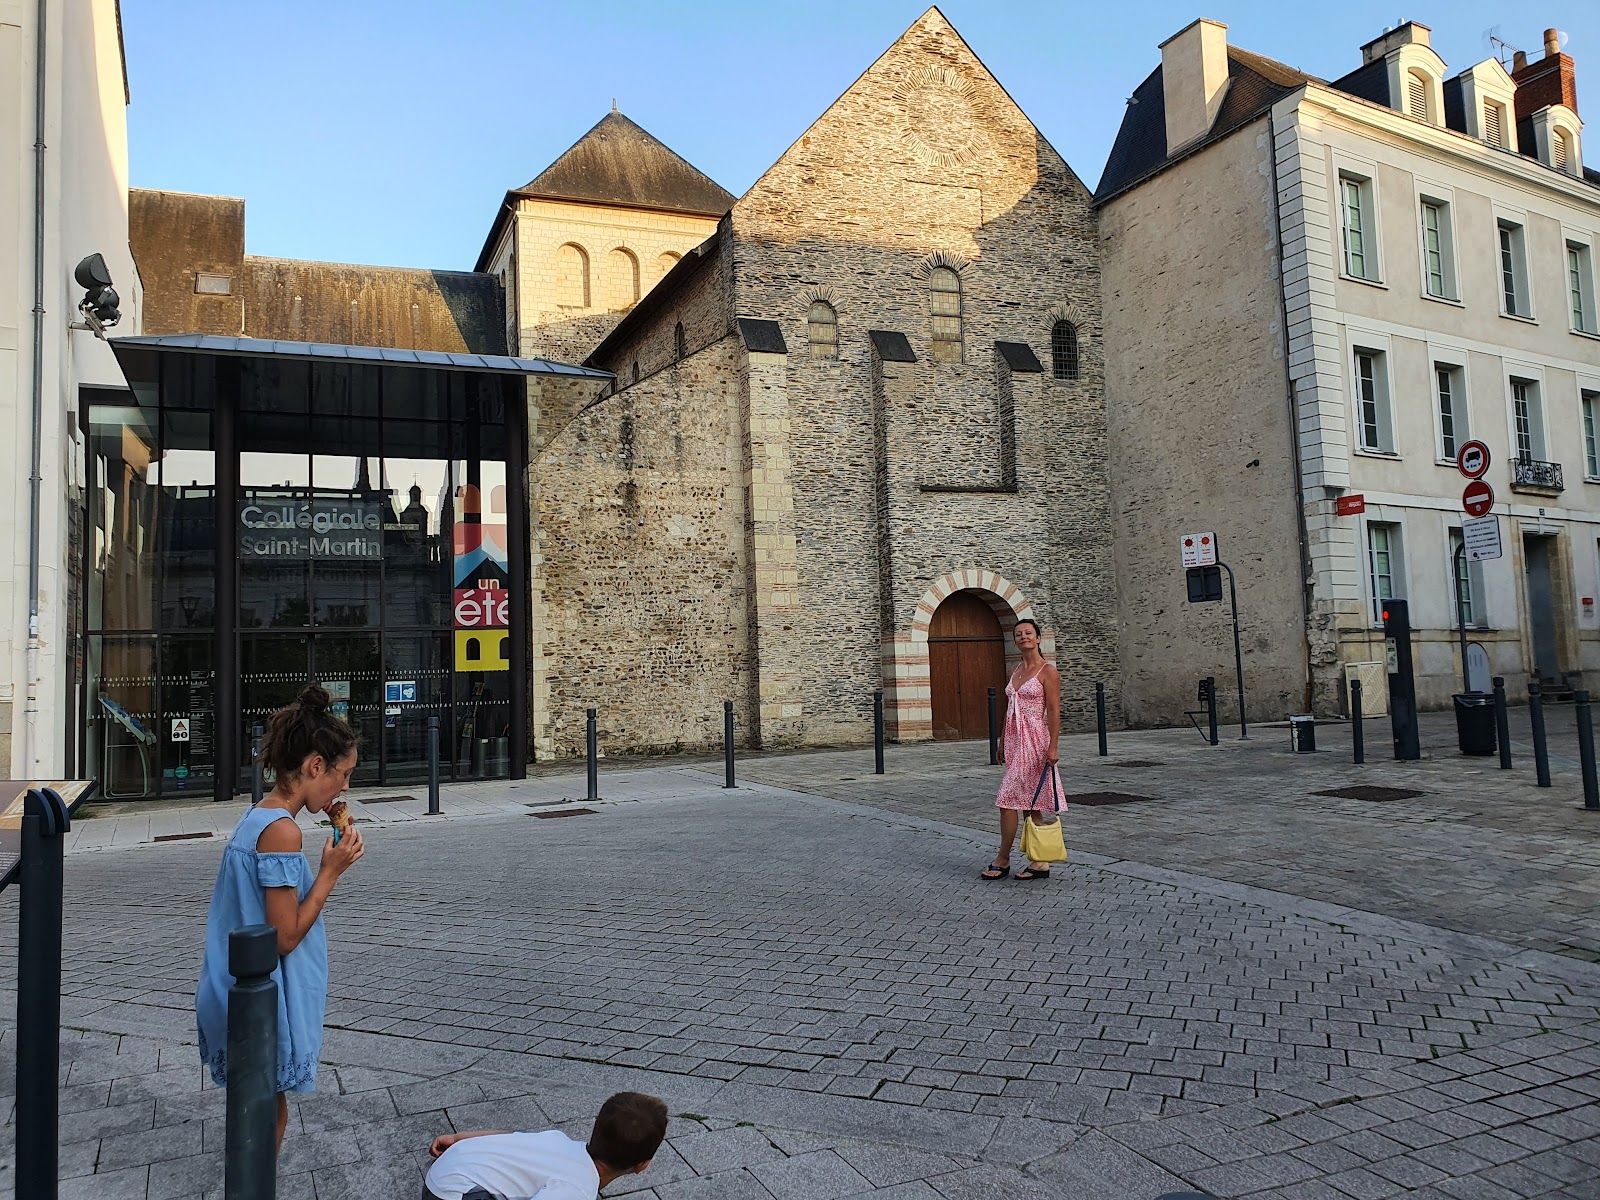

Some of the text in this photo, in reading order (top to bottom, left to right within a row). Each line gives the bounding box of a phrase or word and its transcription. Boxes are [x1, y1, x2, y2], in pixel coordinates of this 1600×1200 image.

[241, 505, 380, 534] Collégiale
[241, 536, 380, 556] Saint-Martin
[478, 579, 500, 590] un
